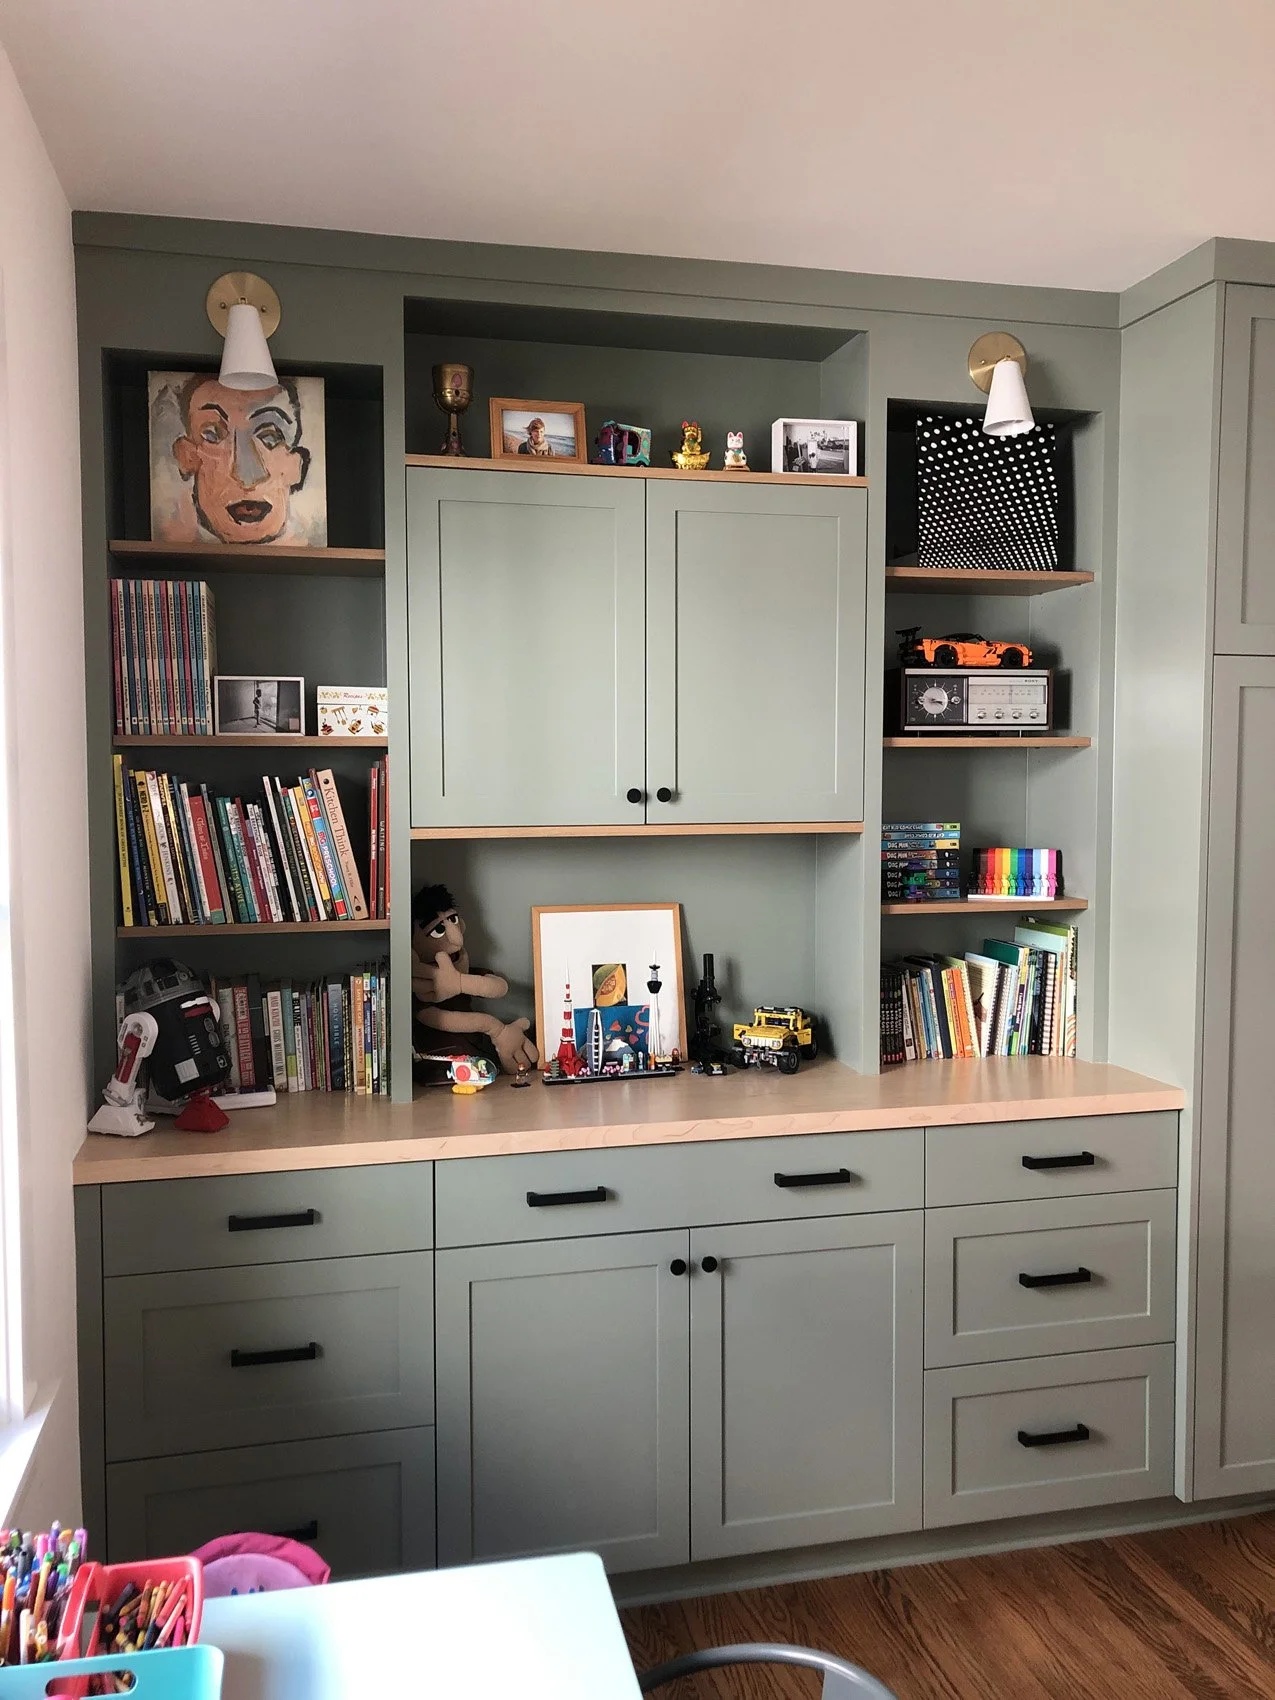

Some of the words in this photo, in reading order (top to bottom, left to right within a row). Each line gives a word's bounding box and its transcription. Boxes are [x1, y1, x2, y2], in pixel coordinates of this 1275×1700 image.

[158, 777, 166, 807] MARVEL
[251, 818, 260, 843] BREATHING
[324, 787, 338, 824] Kitchen
[334, 825, 349, 857] Think
[162, 850, 174, 875] JENKINS
[318, 832, 326, 844] BIG
[322, 846, 337, 888] PRESCHOOL
[231, 869, 240, 880] IT'S
[234, 883, 244, 904] ALIVE
